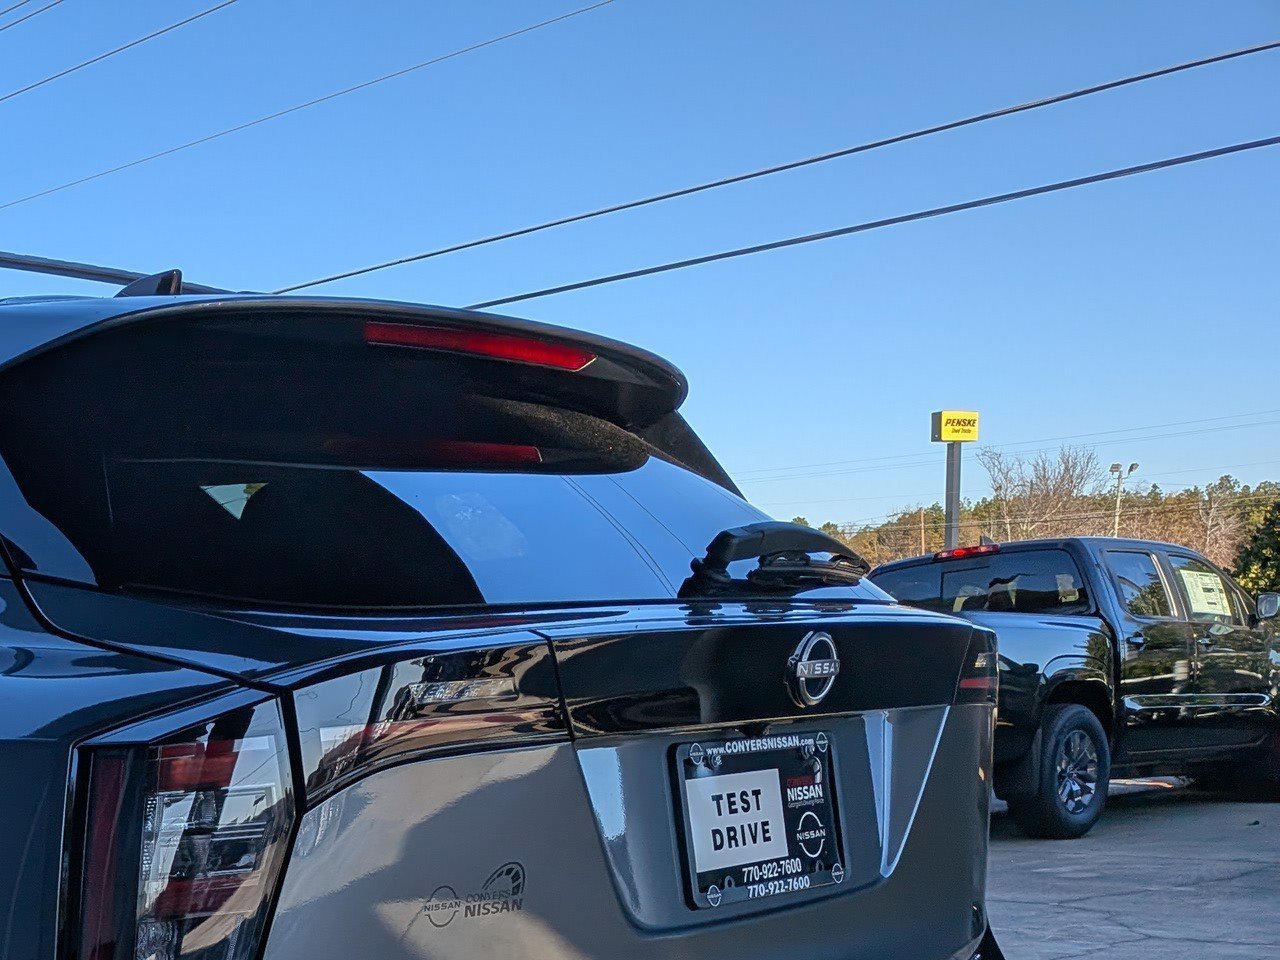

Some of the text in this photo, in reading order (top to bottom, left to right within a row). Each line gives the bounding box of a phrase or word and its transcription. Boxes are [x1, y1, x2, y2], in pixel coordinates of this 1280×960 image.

[944, 418, 977, 427] PENSKE
[706, 736, 814, 755] www.CONYERSNISSAN.com
[787, 784, 823, 801] NISSAN
[711, 788, 762, 817] TEST
[711, 820, 771, 851] DRIVE
[796, 828, 826, 841] NISSAN
[742, 858, 802, 883] 770-922-7600
[748, 876, 810, 899] 770-922-7600
[424, 901, 461, 912] NISSAN
[464, 899, 523, 918] NISSAN
